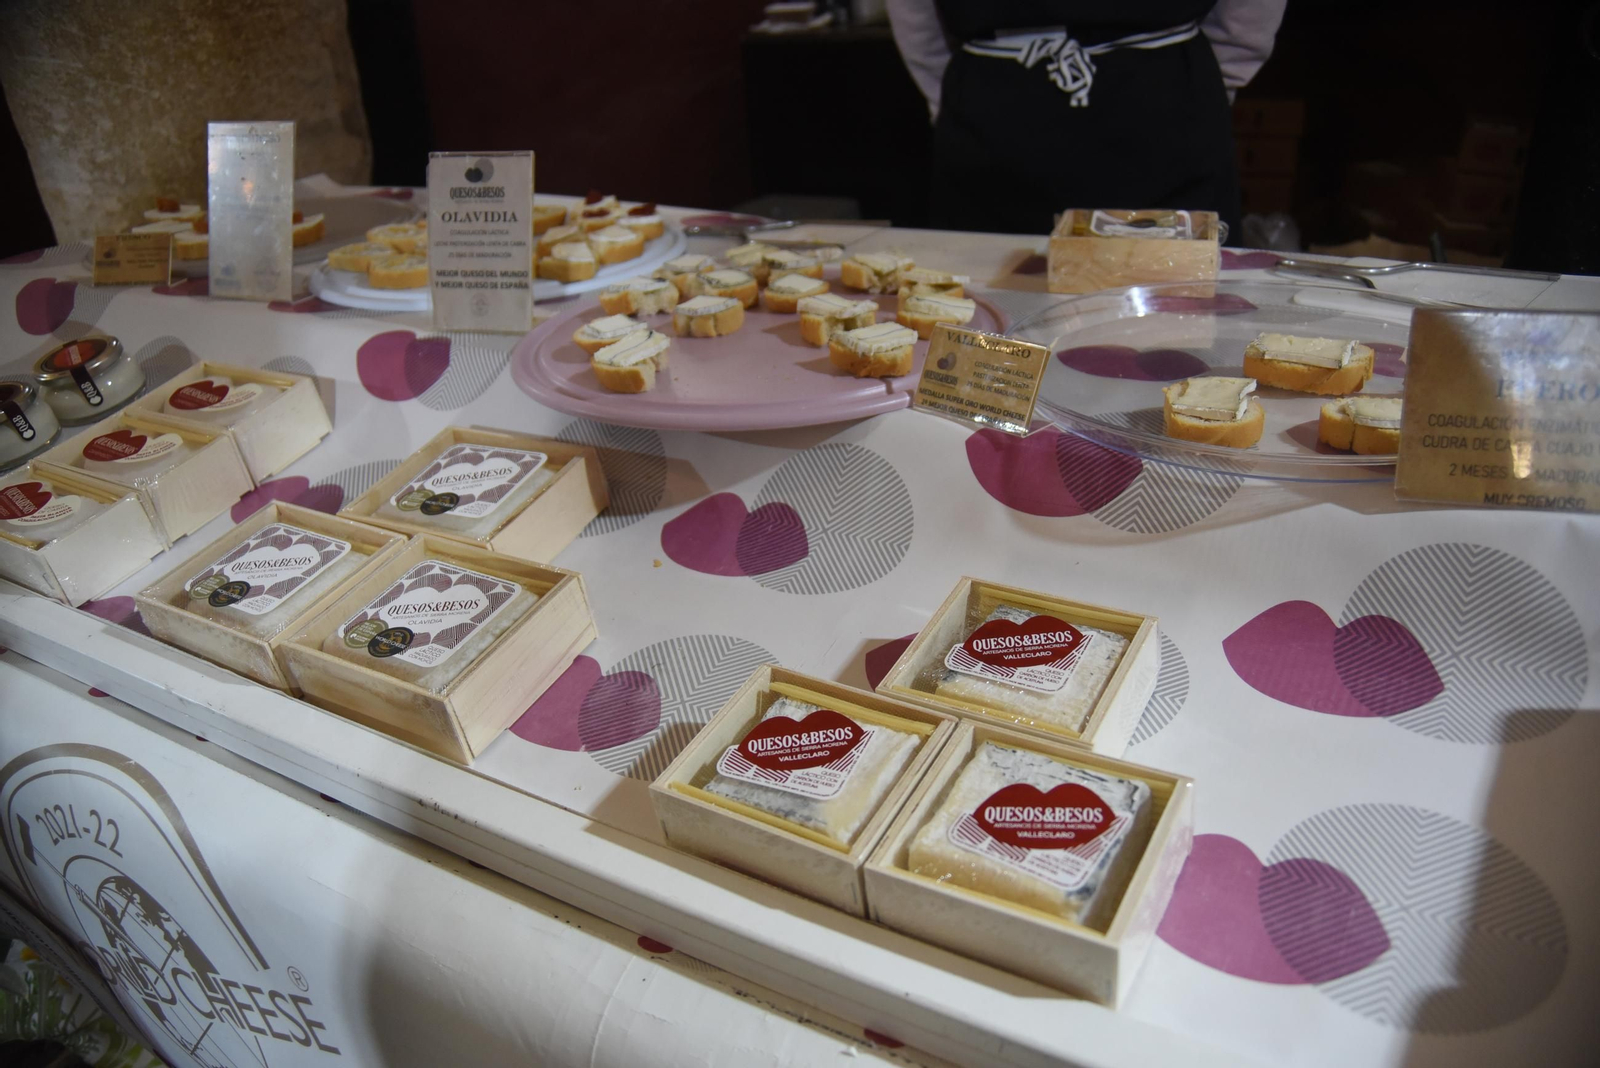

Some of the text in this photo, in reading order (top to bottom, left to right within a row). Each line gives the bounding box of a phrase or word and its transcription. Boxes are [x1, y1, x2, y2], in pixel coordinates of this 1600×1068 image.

[449, 186, 506, 199] QUESOS&BESOS
[441, 211, 518, 222] OLAVIDIA
[436, 269, 459, 277] MEJOR
[500, 270, 529, 278] MUNDO
[441, 281, 463, 289] MEJOR
[465, 281, 489, 289] QUESO
[500, 280, 530, 289] ESPAÑA
[919, 387, 1026, 421] MEDALLA SUPER ORO WORLD CHEESE
[928, 400, 948, 411] MEJOR
[949, 406, 968, 417] QUESO
[1427, 412, 1524, 431] COAGULACIÓN
[1422, 434, 1468, 450] CUDRA
[1472, 437, 1490, 450] DE
[431, 466, 513, 486] QUESOS&BESOS
[1448, 463, 1457, 477] 2
[1461, 464, 1509, 479] MESES
[1483, 492, 1586, 510] MUY CREMOSO
[231, 556, 314, 572] QUESOS&BESOS
[387, 599, 481, 617] QUESOS&BESOS
[407, 618, 443, 626] OLAVIDIA
[972, 630, 1073, 652] QUESOS&BESOS
[1003, 651, 1052, 660] VALLECLARO
[1045, 668, 1065, 676] QUESO
[748, 726, 853, 753] QUESOS&BESOS
[757, 749, 791, 757] ARTESANOS
[778, 750, 830, 762] VALLECLARO
[821, 770, 841, 778] QUESO
[984, 806, 1103, 823] QUESOS&BESOS
[35, 804, 123, 859] 2021-22
[1016, 831, 1075, 839] VALLECLARO
[170, 967, 342, 1056] CHEESE
